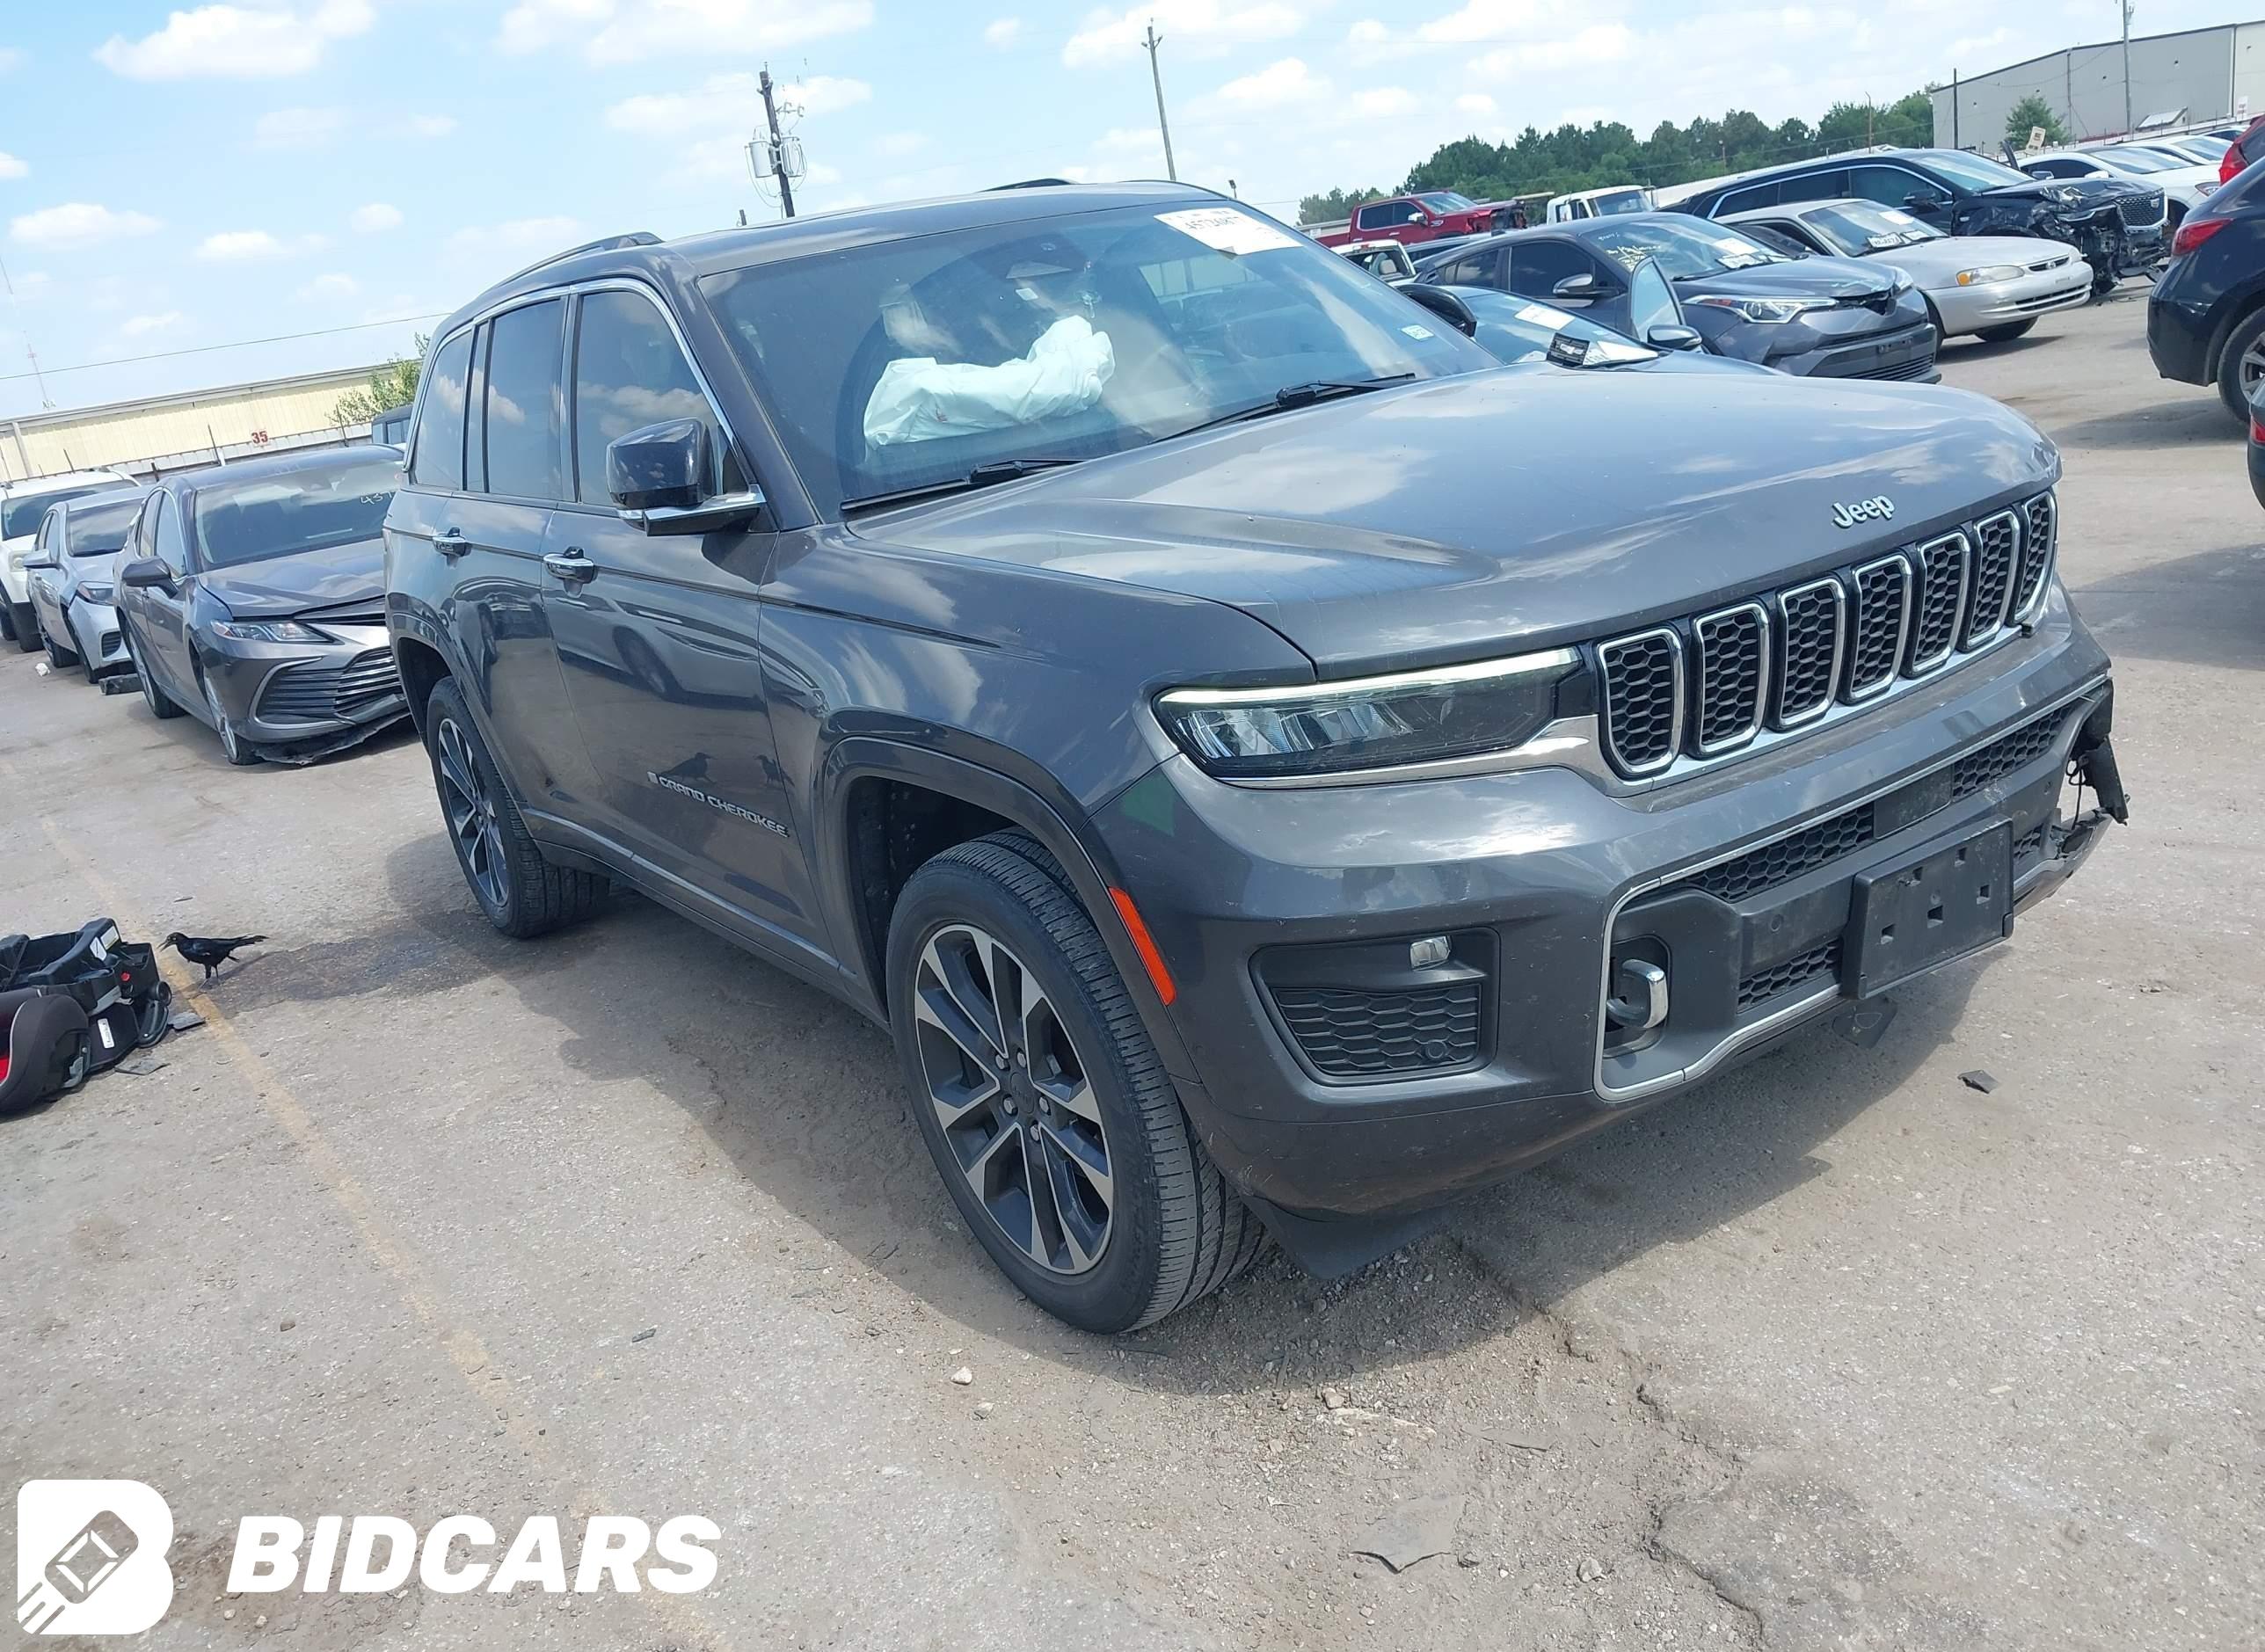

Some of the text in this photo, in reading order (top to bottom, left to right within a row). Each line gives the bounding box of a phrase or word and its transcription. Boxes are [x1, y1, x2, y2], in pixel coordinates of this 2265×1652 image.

[251, 431, 268, 444] 35
[1832, 495, 1895, 528] Jeep
[659, 775, 788, 837] GRAND CHEROKEE
